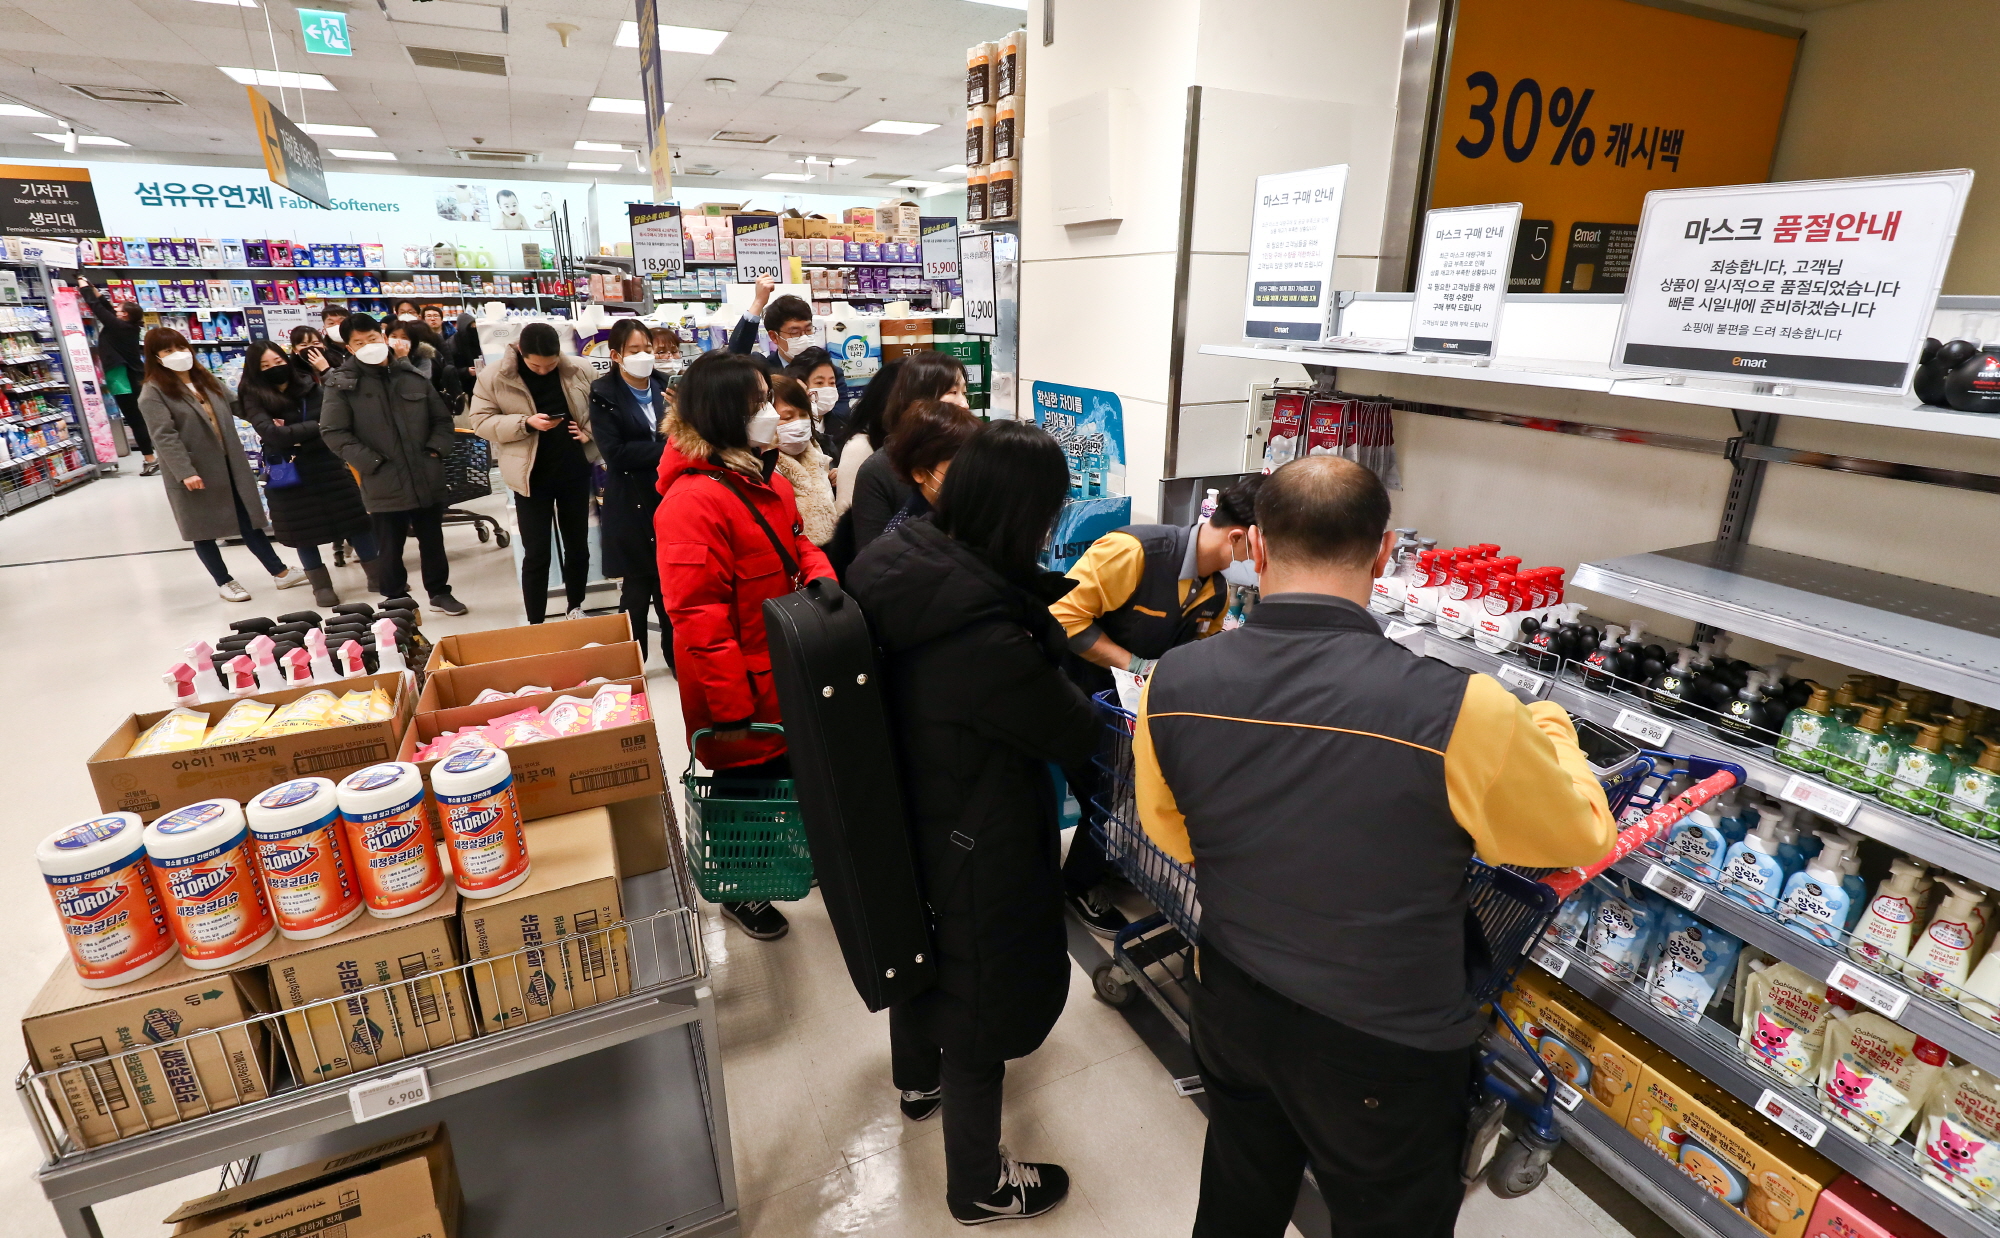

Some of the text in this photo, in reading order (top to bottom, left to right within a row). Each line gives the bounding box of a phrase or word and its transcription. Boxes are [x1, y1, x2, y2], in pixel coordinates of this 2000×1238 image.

[1455, 71, 1685, 173] 30% 캐시백
[20, 183, 69, 198] 기저귀
[134, 182, 274, 210] 섬유유연제
[329, 198, 400, 212] Softeners
[1263, 187, 1334, 207] 마스크 구매 안내
[14, 197, 36, 205] Diaper
[28, 212, 77, 226] 생리대
[1684, 209, 1903, 246] 마스크 품절안내
[1436, 226, 1504, 241] 마스크 구매 안내
[1531, 226, 1549, 260] 5
[1574, 228, 1601, 242] emart
[642, 258, 681, 272] 18,900
[927, 262, 957, 274] 15,900
[1710, 258, 1844, 277] 죄송합니다, 고객님
[1452, 283, 1481, 291] 고객님들을
[1483, 283, 1496, 292] 위해
[1660, 278, 1900, 298] 상품이 일시적으로 품절되었습니다
[1443, 293, 1474, 302] 적정 수량만
[966, 300, 993, 321] 12,900
[1433, 303, 1482, 312] 구매 부탁 드립니다
[1669, 296, 1877, 319] 빠른 시일내에 준비하겠습니다
[1274, 326, 1289, 334] emart
[1682, 322, 1843, 341] 쇼핑에 불편을 드려 죄송합니다
[953, 347, 971, 357] 코디
[1732, 354, 1767, 370] emart
[1037, 389, 1083, 414] 확실한 차이를
[172, 744, 277, 772] 아이! 깨끗해
[124, 798, 139, 806] 200
[125, 789, 147, 798] 리필형
[461, 795, 472, 803] 쉽고
[472, 789, 492, 801] 간편하게
[362, 802, 411, 822] 청소를 쉽고 간편하게
[449, 805, 470, 821] 유한
[451, 803, 499, 835] CLOROX
[269, 831, 281, 839] 쉽고
[280, 828, 303, 838] 간편하게
[364, 821, 388, 839] 유한
[367, 817, 417, 853] CLOROX
[258, 843, 278, 857] 유한
[454, 830, 505, 851] 세정살균티슈
[1681, 840, 1711, 858] 말랑이
[165, 848, 221, 867] 청소를 쉽고 간편하게
[262, 844, 311, 871] CLOROX
[369, 844, 425, 869] 세정살균티슈
[52, 866, 111, 884] 청소를 쉽고 간편하게
[168, 867, 193, 884] 유한
[172, 862, 230, 900] CLOROX
[1734, 865, 1764, 886] 말랑이
[55, 886, 81, 904] 유한
[59, 883, 121, 918] CLOROX
[176, 892, 239, 917] 세정살균티슈
[1797, 896, 1831, 919] 말랑이
[1602, 908, 1634, 932] 말랑이
[1869, 921, 1898, 935] 사이사이로
[1670, 939, 1703, 966] 말랑이
[1929, 947, 1960, 962] 사이사이로
[1772, 978, 1804, 995] Babience
[184, 994, 201, 1007] UP
[1770, 986, 1820, 1015] 사이사이로
[510, 1006, 524, 1019] UP
[1567, 1029, 1597, 1053] 핸드워시
[1854, 1027, 1889, 1045] Babience
[1852, 1034, 1905, 1067] 사이사이로
[334, 1056, 348, 1070] UP
[161, 1049, 200, 1105] 세정살균티슈
[1652, 1083, 1675, 1103] SAFE
[1959, 1082, 1998, 1106] Babience
[1682, 1111, 1756, 1171] 항균 버블 핸드워시
[1766, 1176, 1795, 1199] GIFT SET
[325, 1213, 343, 1224] 적재
